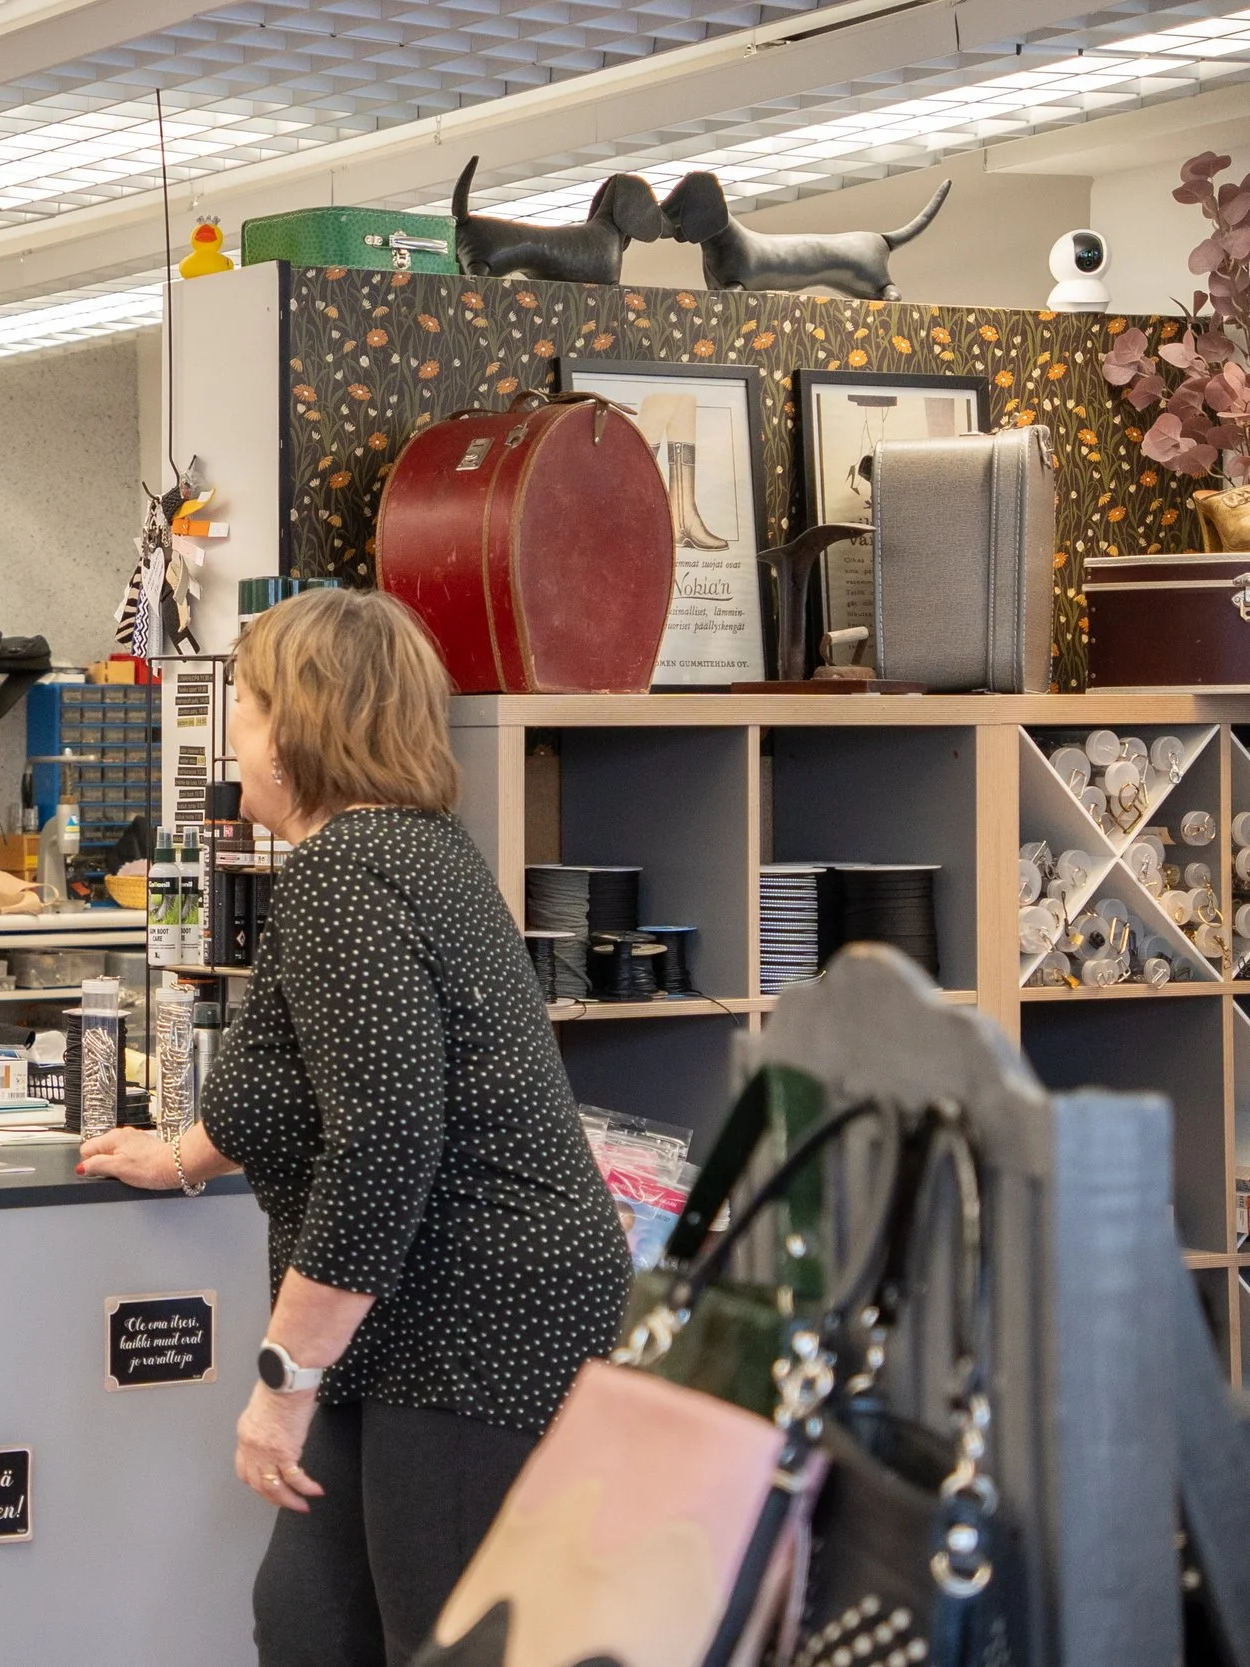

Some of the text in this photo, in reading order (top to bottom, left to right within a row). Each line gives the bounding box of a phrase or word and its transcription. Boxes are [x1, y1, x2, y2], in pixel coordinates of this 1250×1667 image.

[726, 561, 741, 569] ovat
[694, 620, 745, 635] päällyskengät
[679, 660, 735, 668] GUMMITEHDAS
[737, 660, 750, 668] OY.
[124, 1314, 199, 1332] Ole oma itsesi,
[119, 1329, 204, 1350] kaikki muut ovat
[128, 1350, 194, 1374] jo varattuja
